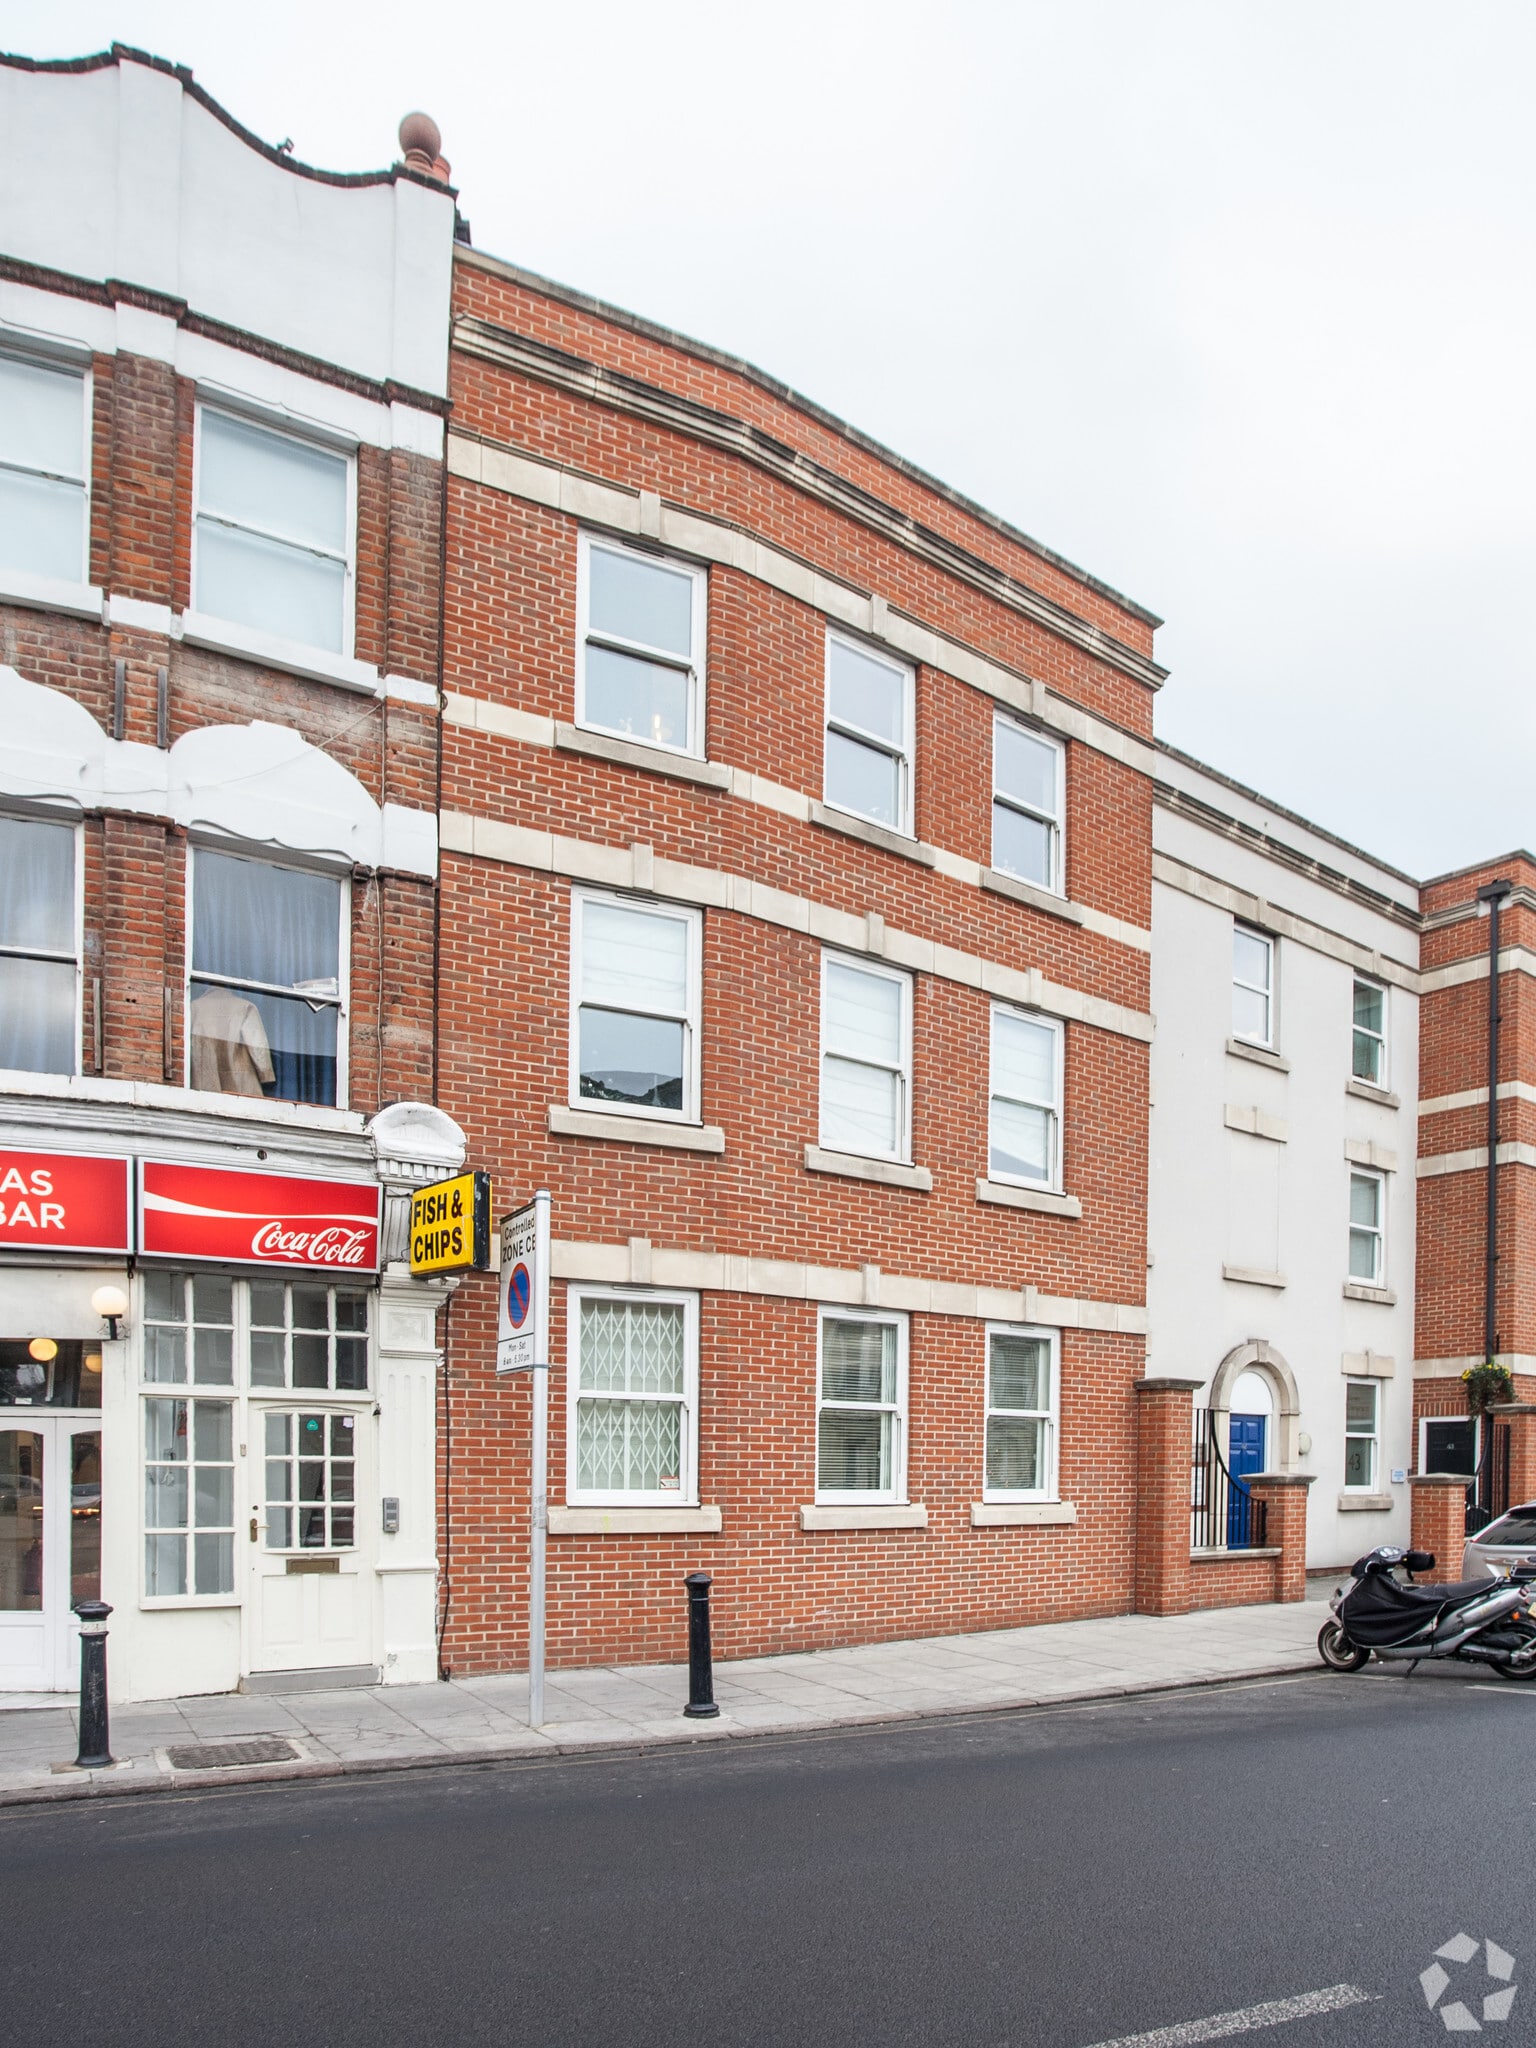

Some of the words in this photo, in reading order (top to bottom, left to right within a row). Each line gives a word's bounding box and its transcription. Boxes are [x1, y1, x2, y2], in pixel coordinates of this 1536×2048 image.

[0, 1167, 53, 1196] AS
[413, 1193, 447, 1228] FISH
[451, 1189, 463, 1218] &
[504, 1213, 535, 1240] Controlled
[251, 1221, 373, 1263] Coca-Cola
[414, 1226, 462, 1263] CHIPS
[502, 1239, 523, 1263] ZONE
[1348, 1453, 1361, 1471] 43
